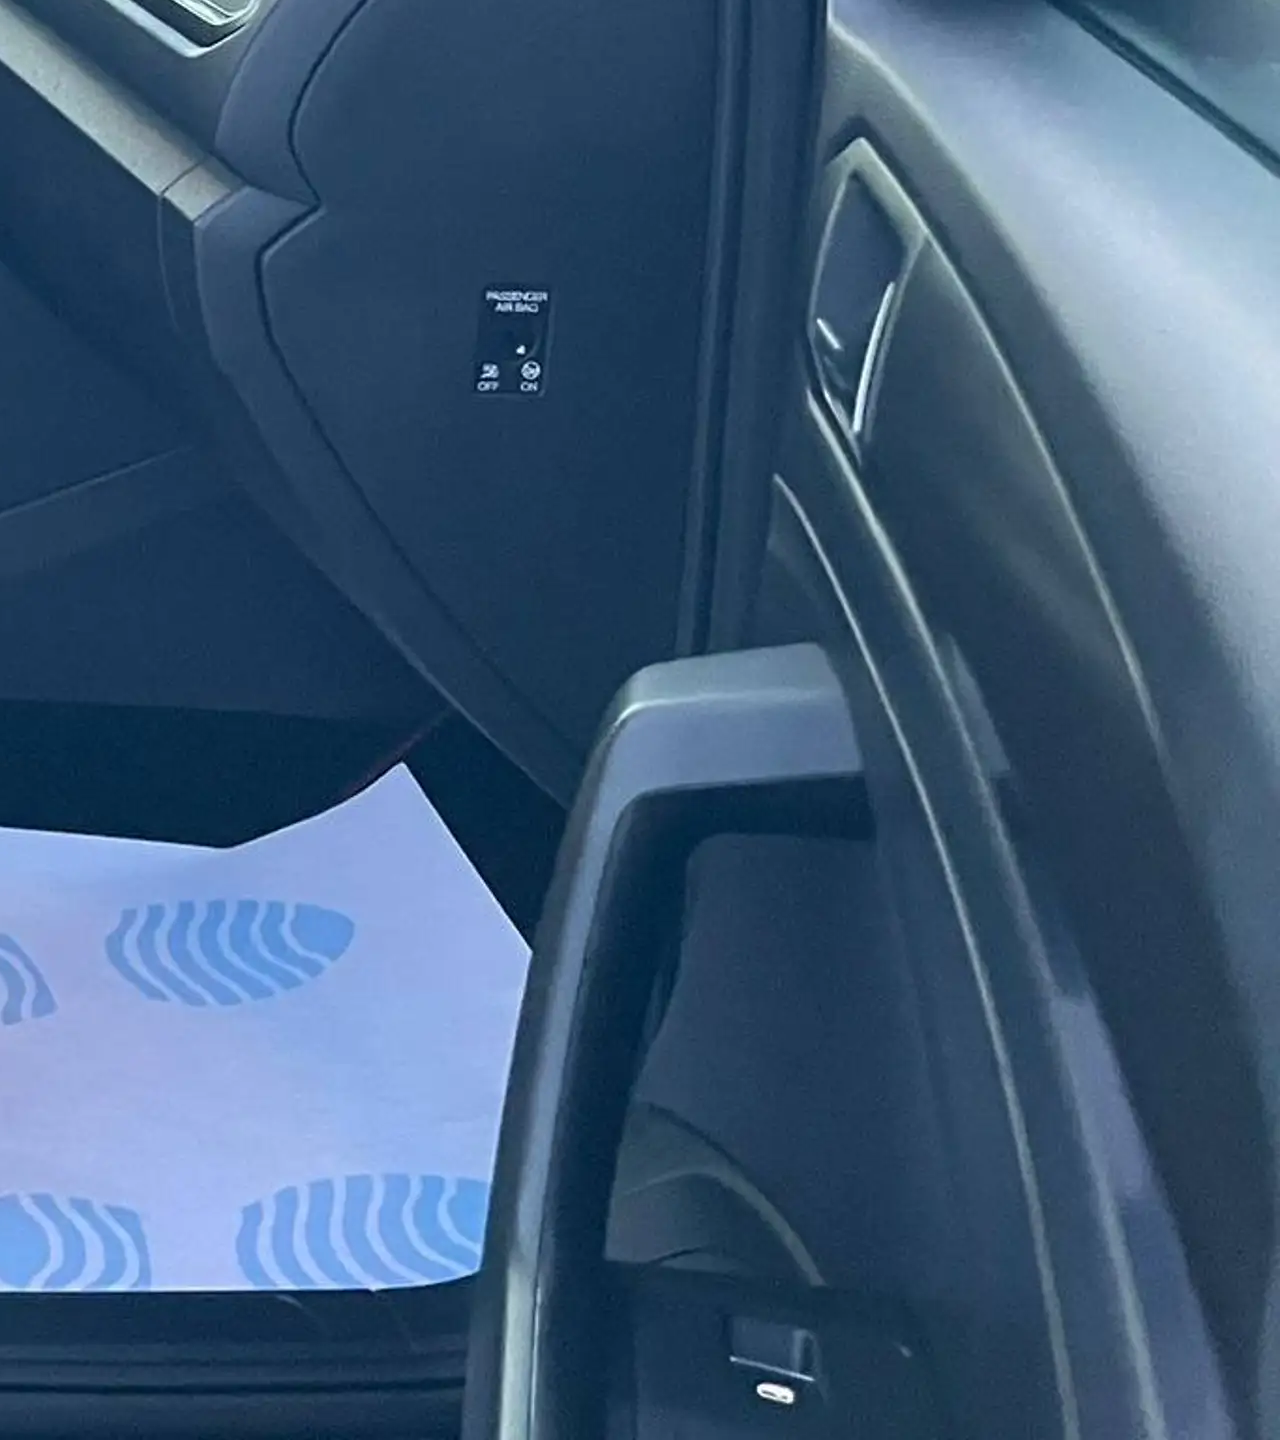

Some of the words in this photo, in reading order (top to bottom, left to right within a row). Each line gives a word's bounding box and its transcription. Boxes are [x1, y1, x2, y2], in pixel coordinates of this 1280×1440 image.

[485, 290, 548, 302] PASSENGER
[477, 381, 500, 392] OFF
[520, 381, 538, 392] ON
